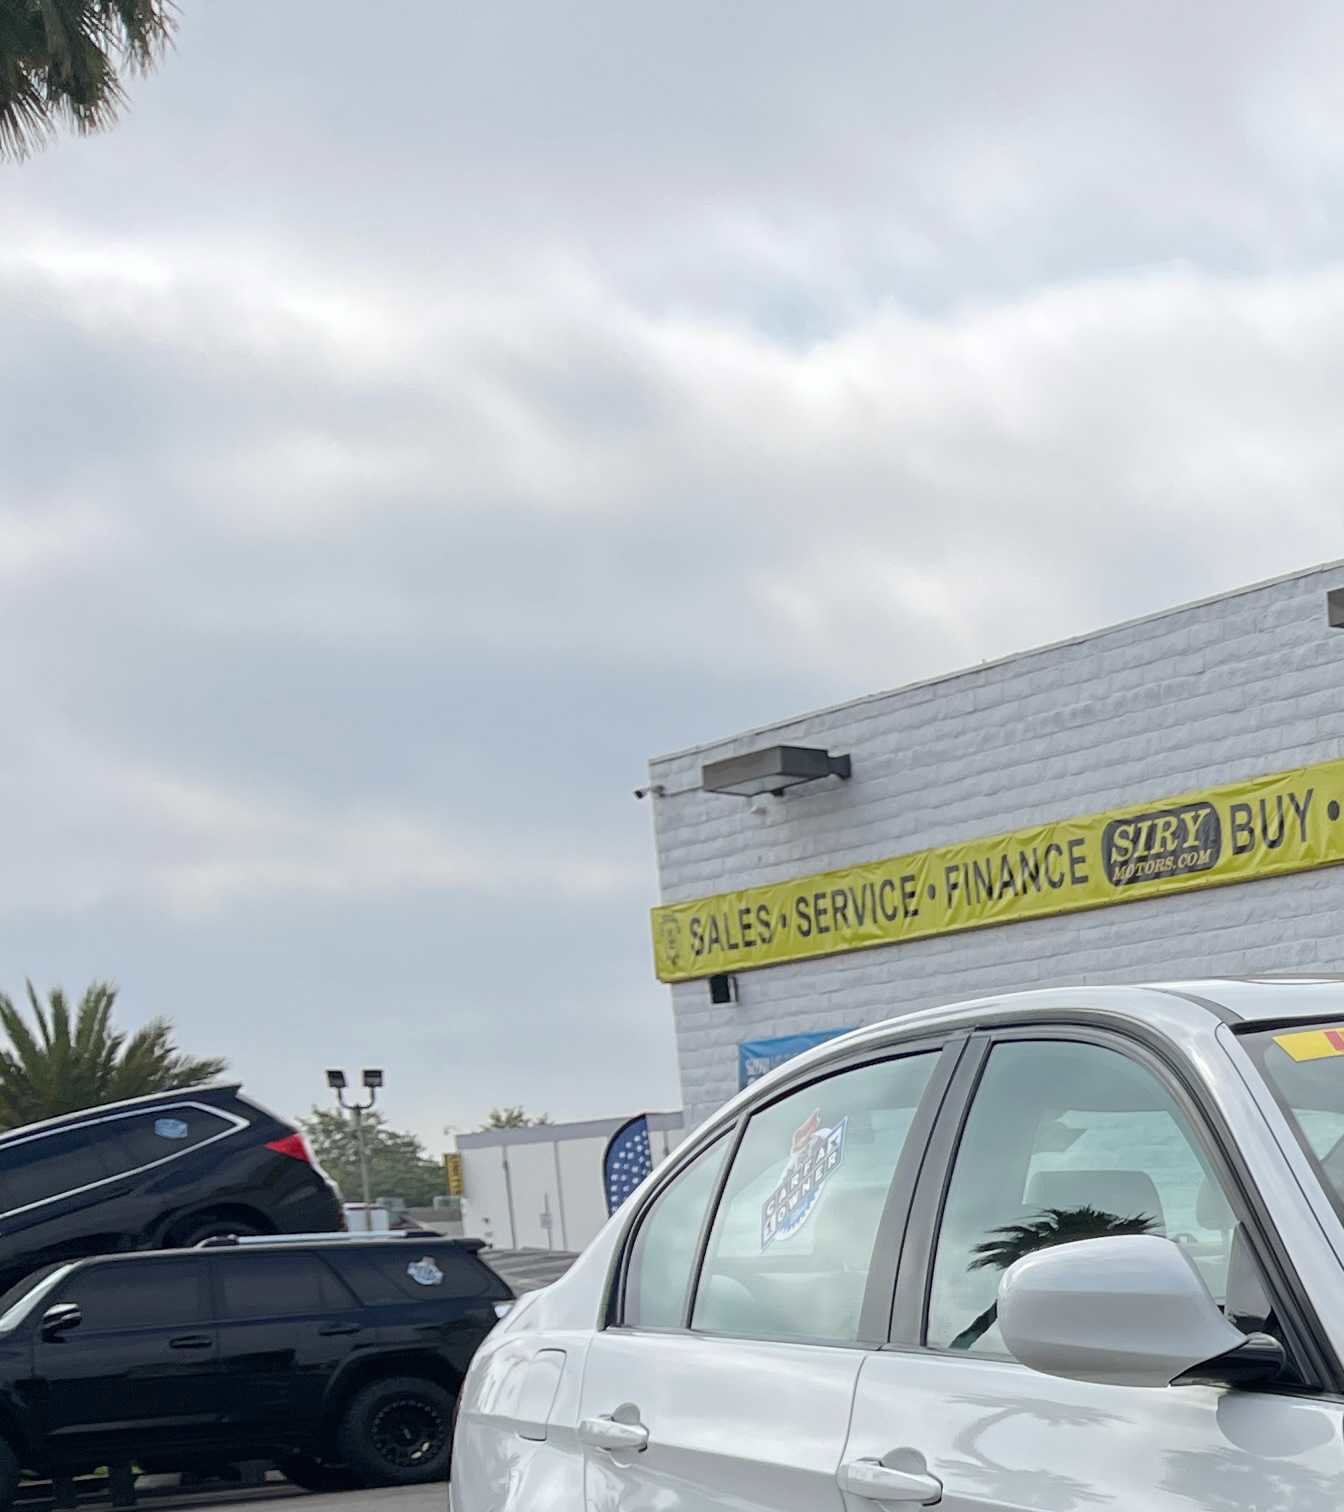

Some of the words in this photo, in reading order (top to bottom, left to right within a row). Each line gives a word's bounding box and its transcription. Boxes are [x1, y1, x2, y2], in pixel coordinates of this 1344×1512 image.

[1110, 808, 1211, 864] SIRY
[1230, 788, 1314, 856] BUY
[1113, 849, 1213, 881] MOTORS.COM
[689, 903, 772, 956] SALES
[796, 874, 919, 938] SERVICE
[943, 838, 1089, 909] FINANCE
